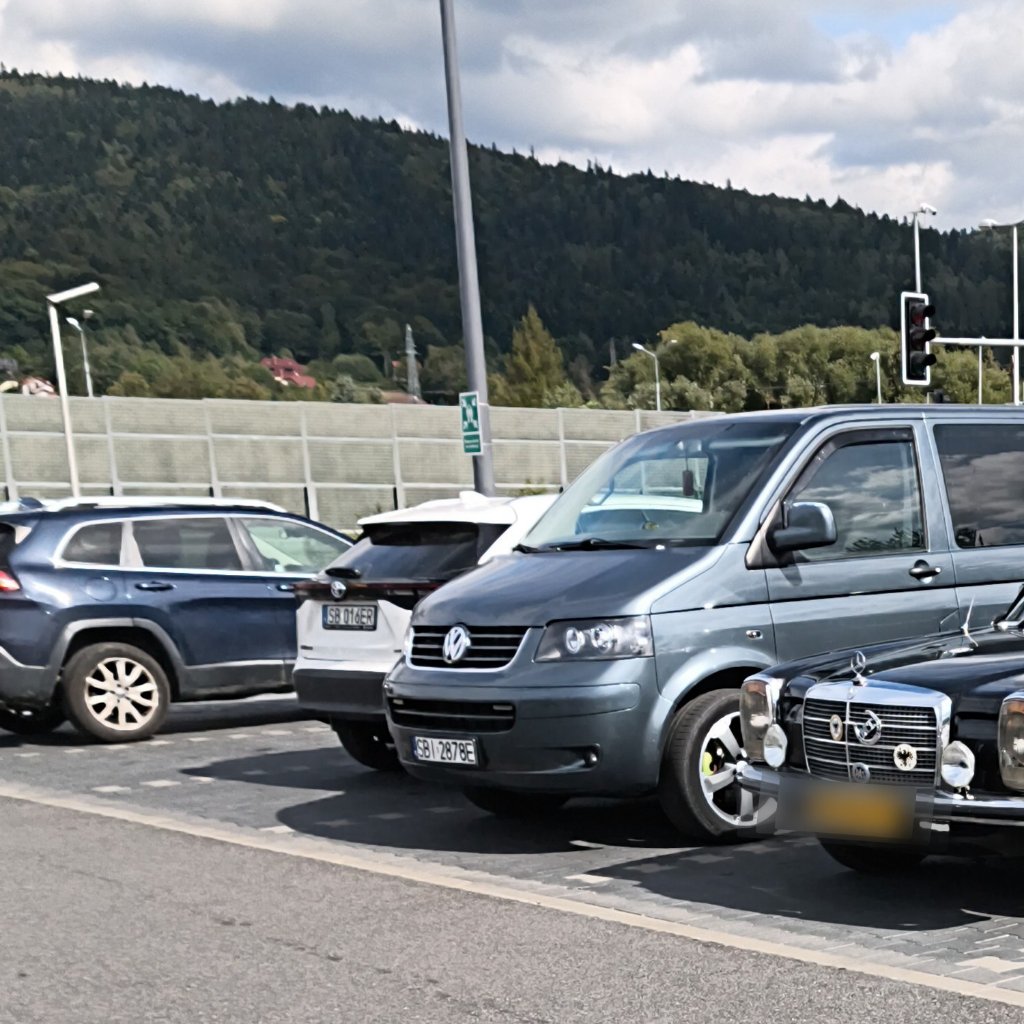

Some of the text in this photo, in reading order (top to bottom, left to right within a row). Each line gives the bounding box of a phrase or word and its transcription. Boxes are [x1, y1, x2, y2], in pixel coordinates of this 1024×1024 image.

[329, 607, 340, 624] SB
[417, 738, 475, 763] SBI 2878E
